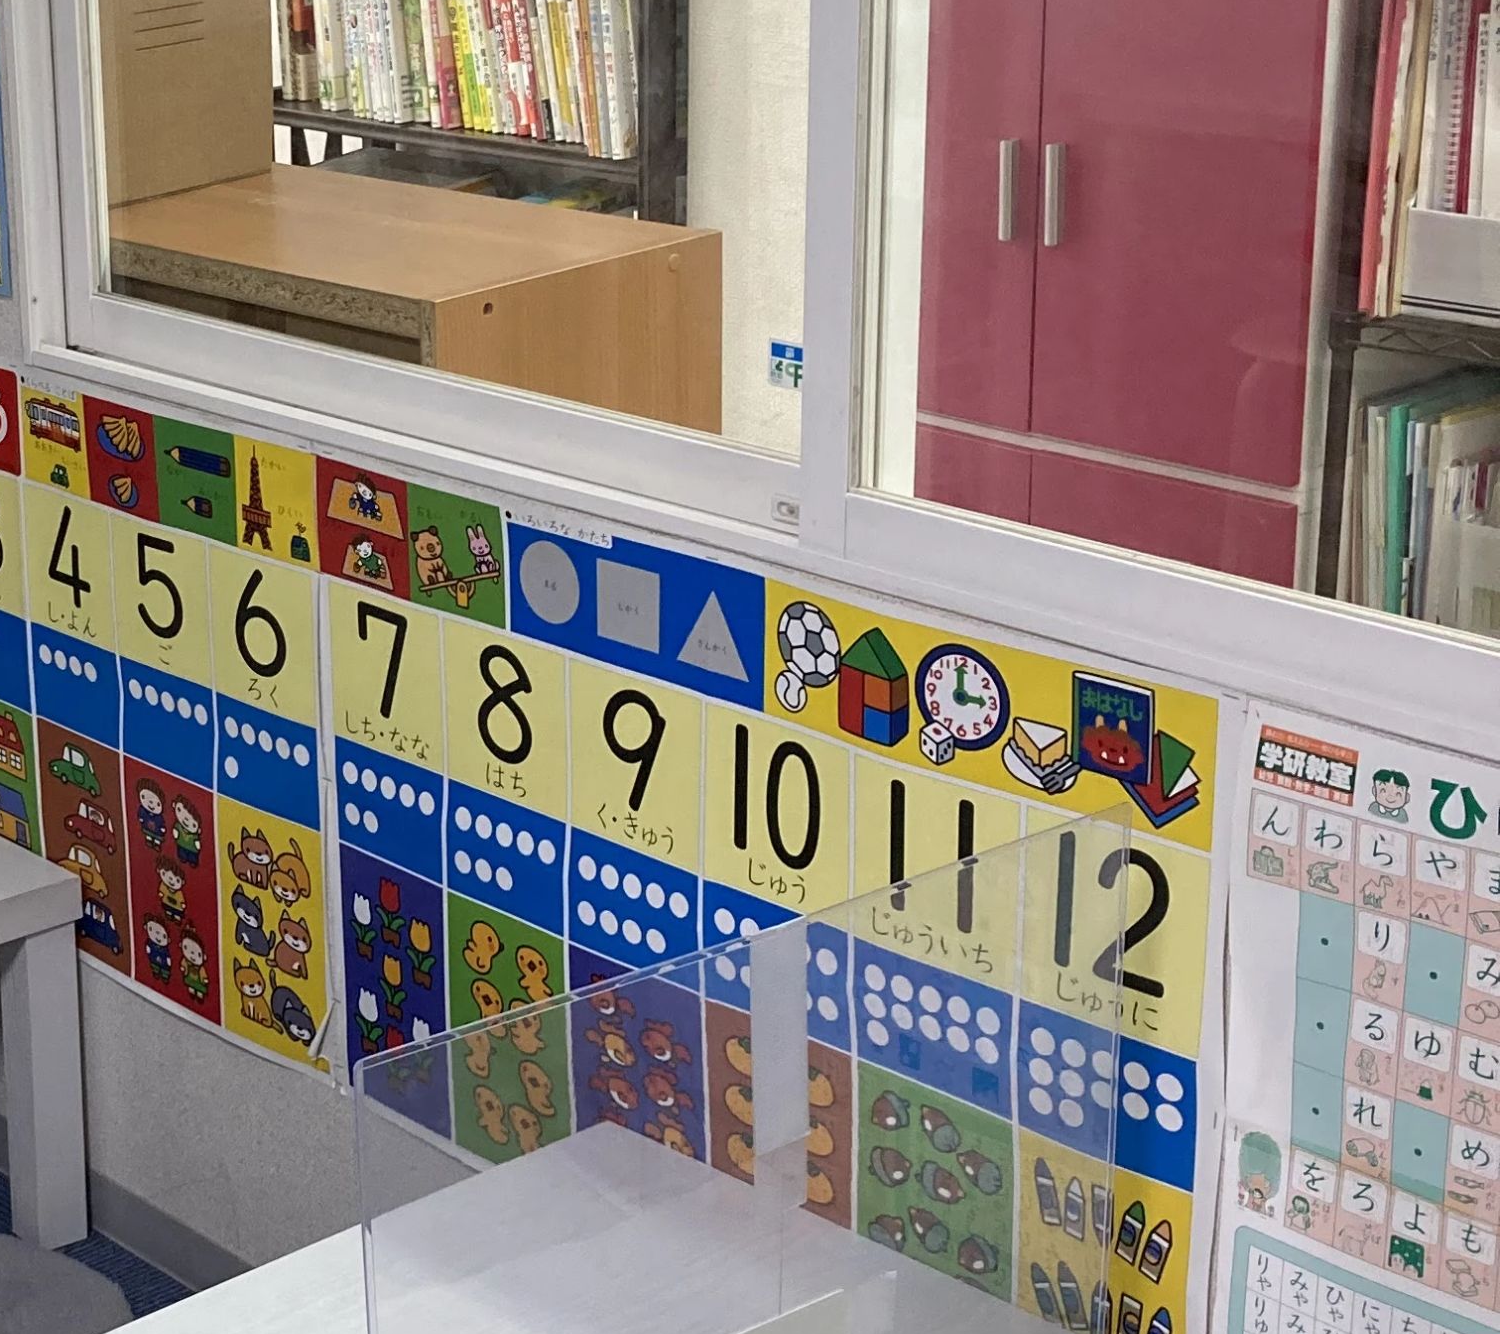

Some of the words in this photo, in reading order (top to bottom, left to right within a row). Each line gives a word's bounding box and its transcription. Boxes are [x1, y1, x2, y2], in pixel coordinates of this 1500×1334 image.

[49, 505, 92, 609] 4
[514, 512, 571, 537] いろいろな
[577, 526, 611, 548] かたち
[137, 532, 184, 640] 5
[235, 568, 287, 678] 6
[159, 644, 173, 666] ご
[357, 601, 408, 719] 7
[249, 678, 279, 709] ろく
[477, 644, 533, 765] 8
[926, 682, 936, 698] 9
[930, 700, 941, 717] 8
[981, 677, 991, 690] 2
[988, 696, 998, 711] 3
[1081, 686, 1144, 723] おはなし
[956, 724, 967, 738] 6
[972, 722, 982, 736] 5
[983, 713, 994, 727] 4
[602, 688, 667, 812] 9
[1258, 741, 1354, 790] 学研教室
[485, 761, 527, 798] はち
[733, 723, 822, 870] 10
[1429, 778, 1488, 840] ひ
[890, 779, 975, 934] 11
[1262, 806, 1290, 836] ん
[1313, 818, 1343, 850] わ
[1373, 833, 1393, 867] ら
[1425, 850, 1457, 879] や
[746, 857, 807, 905] じゅう
[870, 907, 995, 974] じゅういち
[1054, 830, 1170, 998] 12
[1374, 921, 1390, 952] り
[1364, 1012, 1384, 1041] る
[1414, 1030, 1441, 1058] ゆ
[1469, 1047, 1499, 1079] む
[1352, 1096, 1382, 1127] れ
[1460, 1140, 1490, 1166] め
[1303, 1161, 1325, 1192] を
[1352, 1182, 1375, 1212] ろ
[1404, 1203, 1426, 1235] よ
[1461, 1225, 1481, 1254] も
